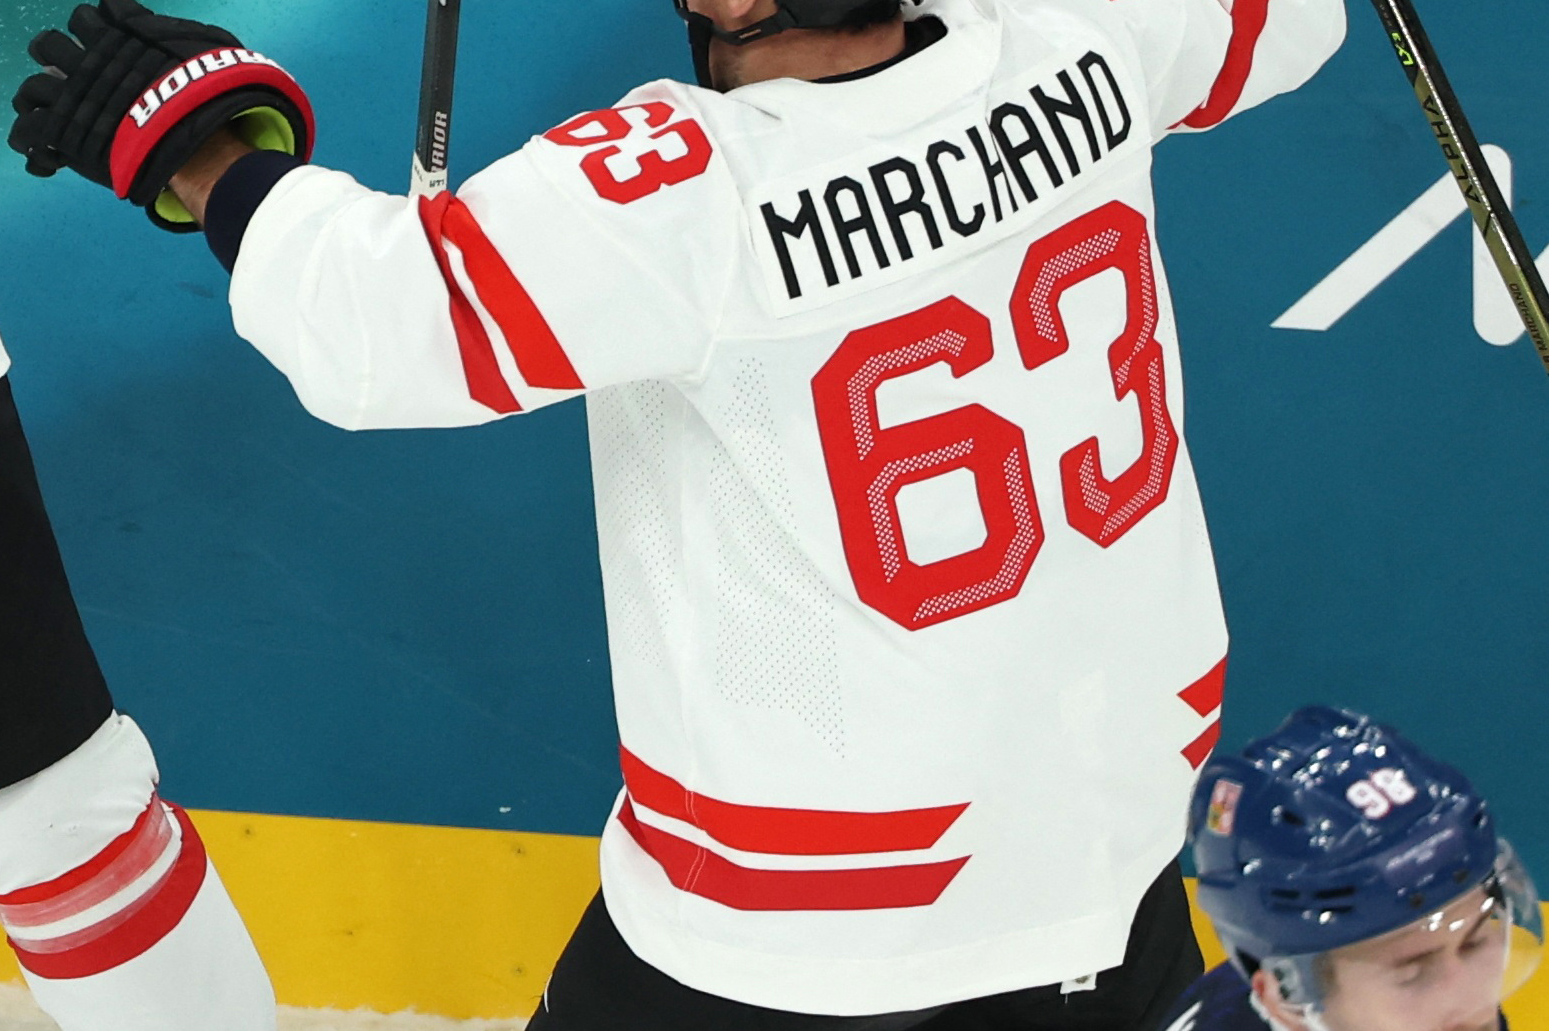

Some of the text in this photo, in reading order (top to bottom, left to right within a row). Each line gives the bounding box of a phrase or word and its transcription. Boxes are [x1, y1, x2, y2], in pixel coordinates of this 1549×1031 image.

[542, 100, 714, 205] 63
[760, 50, 1133, 300] MARCHAND
[1422, 94, 1481, 205] ALPHA
[810, 199, 1179, 632] 63
